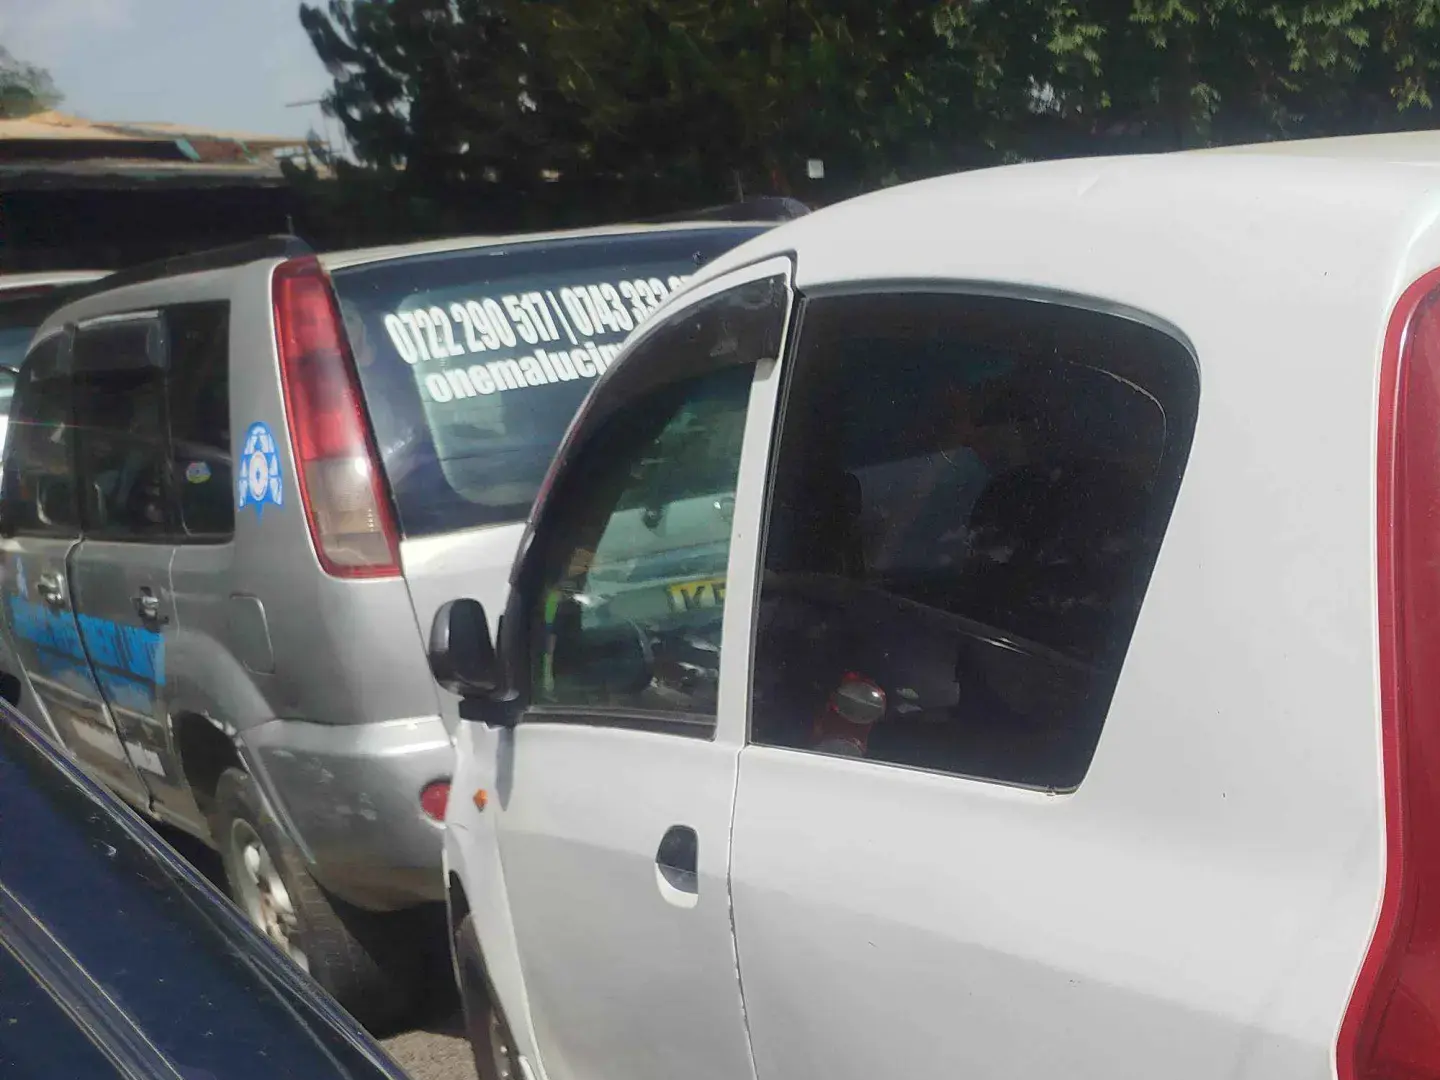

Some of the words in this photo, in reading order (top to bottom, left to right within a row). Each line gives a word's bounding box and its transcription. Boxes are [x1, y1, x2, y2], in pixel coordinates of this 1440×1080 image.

[384, 306, 466, 365] 0722
[451, 298, 517, 352] 290
[502, 291, 561, 344] 517
[559, 282, 634, 337] 0743
